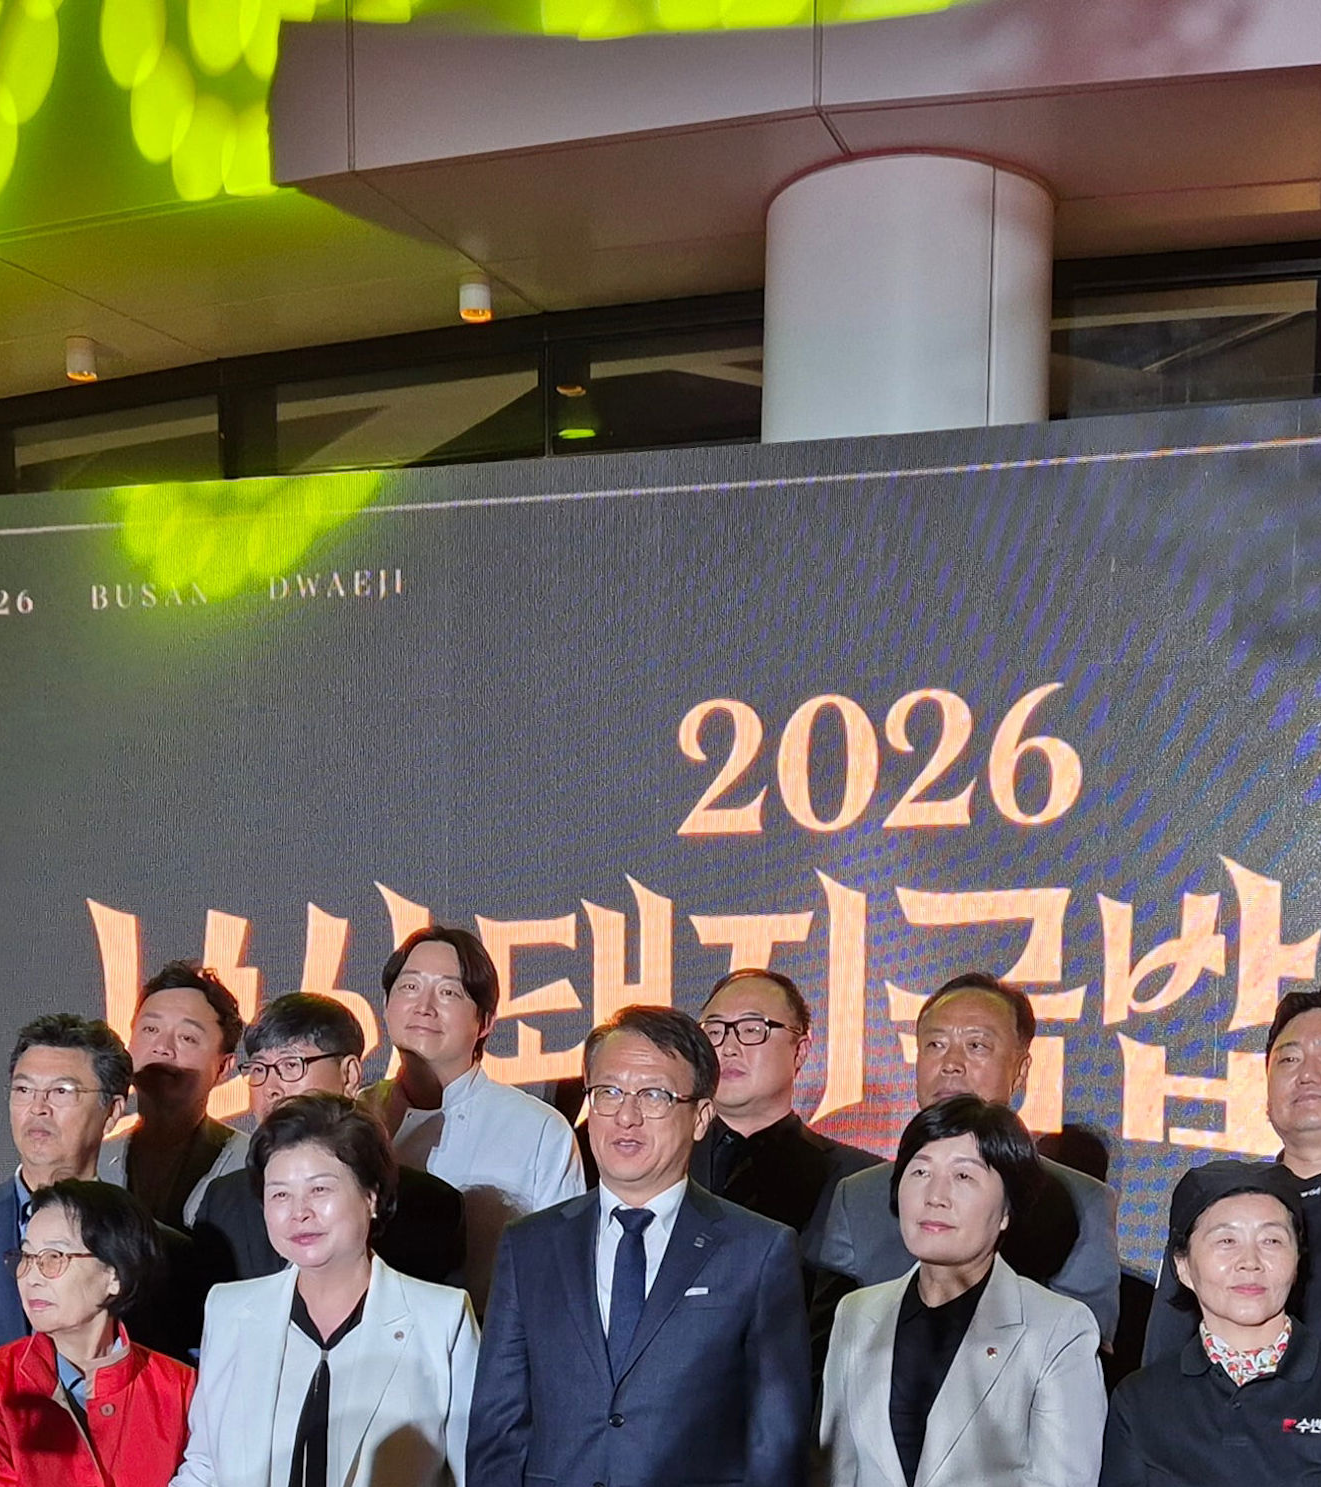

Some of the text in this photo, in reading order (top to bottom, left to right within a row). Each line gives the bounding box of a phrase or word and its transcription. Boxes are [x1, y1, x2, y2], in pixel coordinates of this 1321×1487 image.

[90, 582, 209, 610] BUSAN
[269, 569, 402, 600] DWAEJI
[676, 681, 1083, 836] 2026
